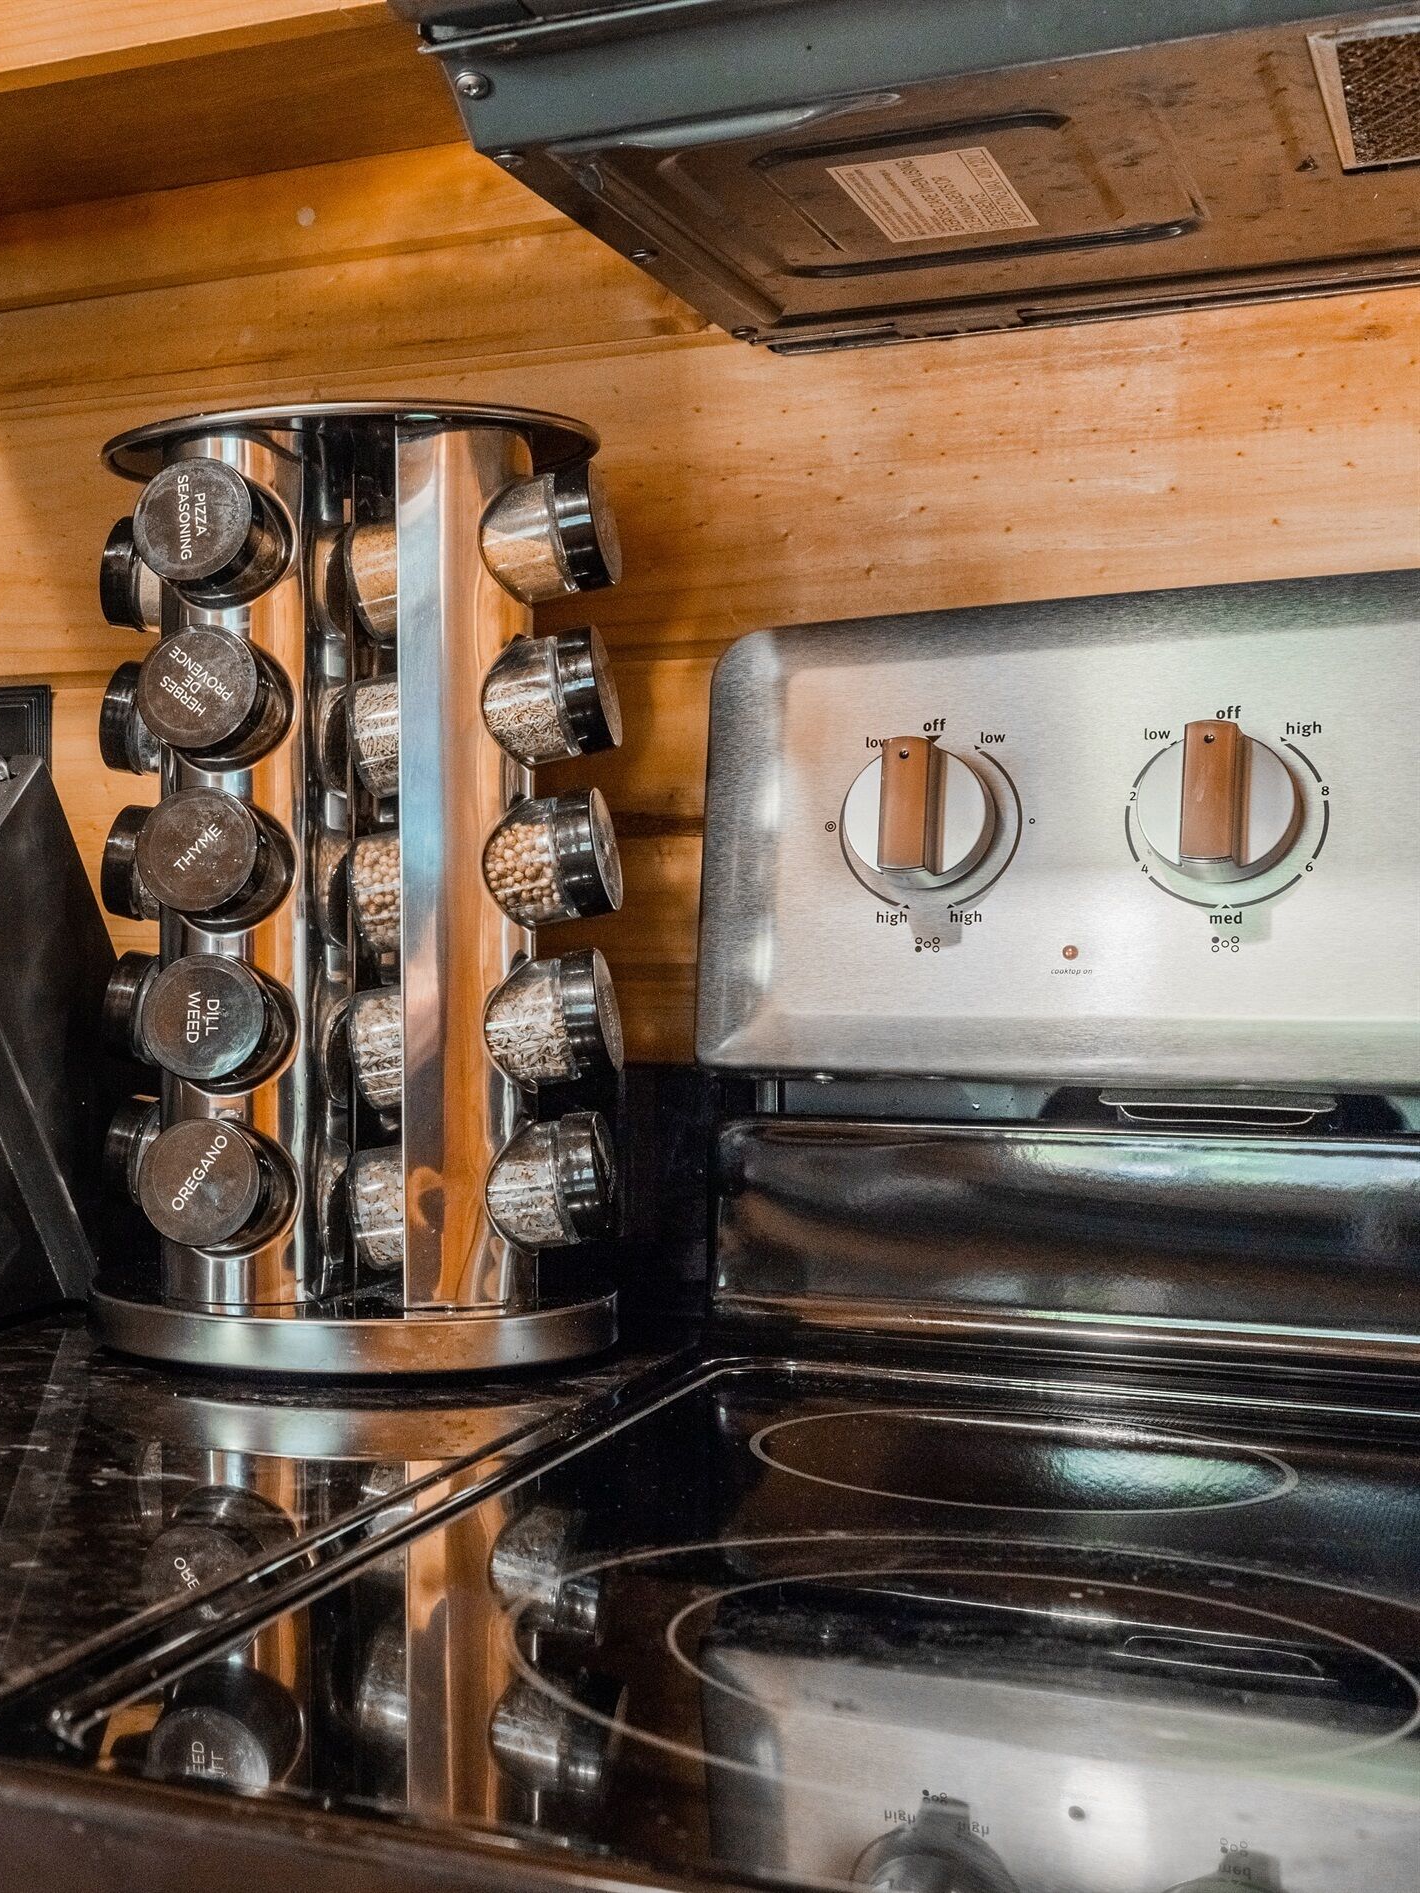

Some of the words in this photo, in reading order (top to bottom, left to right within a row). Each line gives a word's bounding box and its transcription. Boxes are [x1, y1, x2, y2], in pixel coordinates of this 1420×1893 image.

[919, 191, 947, 208] CARE
[177, 474, 192, 561] SEASONING
[194, 492, 208, 537] PIZZA
[170, 645, 234, 701] PROVENCE
[181, 678, 202, 694] DE
[160, 675, 207, 717] HERBES
[1215, 705, 1242, 719] off
[923, 718, 947, 732] off
[1286, 720, 1322, 737] high
[980, 731, 1006, 744] low
[1144, 728, 1171, 740] low
[1129, 792, 1137, 801] 2
[1321, 786, 1330, 796] 8
[173, 823, 222, 872] THYME
[1141, 864, 1149, 874] 4
[1305, 862, 1314, 872] 6
[876, 911, 908, 926] high
[950, 910, 982, 926] high
[1209, 911, 1243, 925] med
[1050, 968, 1081, 976] cooktop
[186, 991, 201, 1043] WEED
[206, 999, 220, 1036] DILL
[171, 1135, 228, 1211] OREGANO
